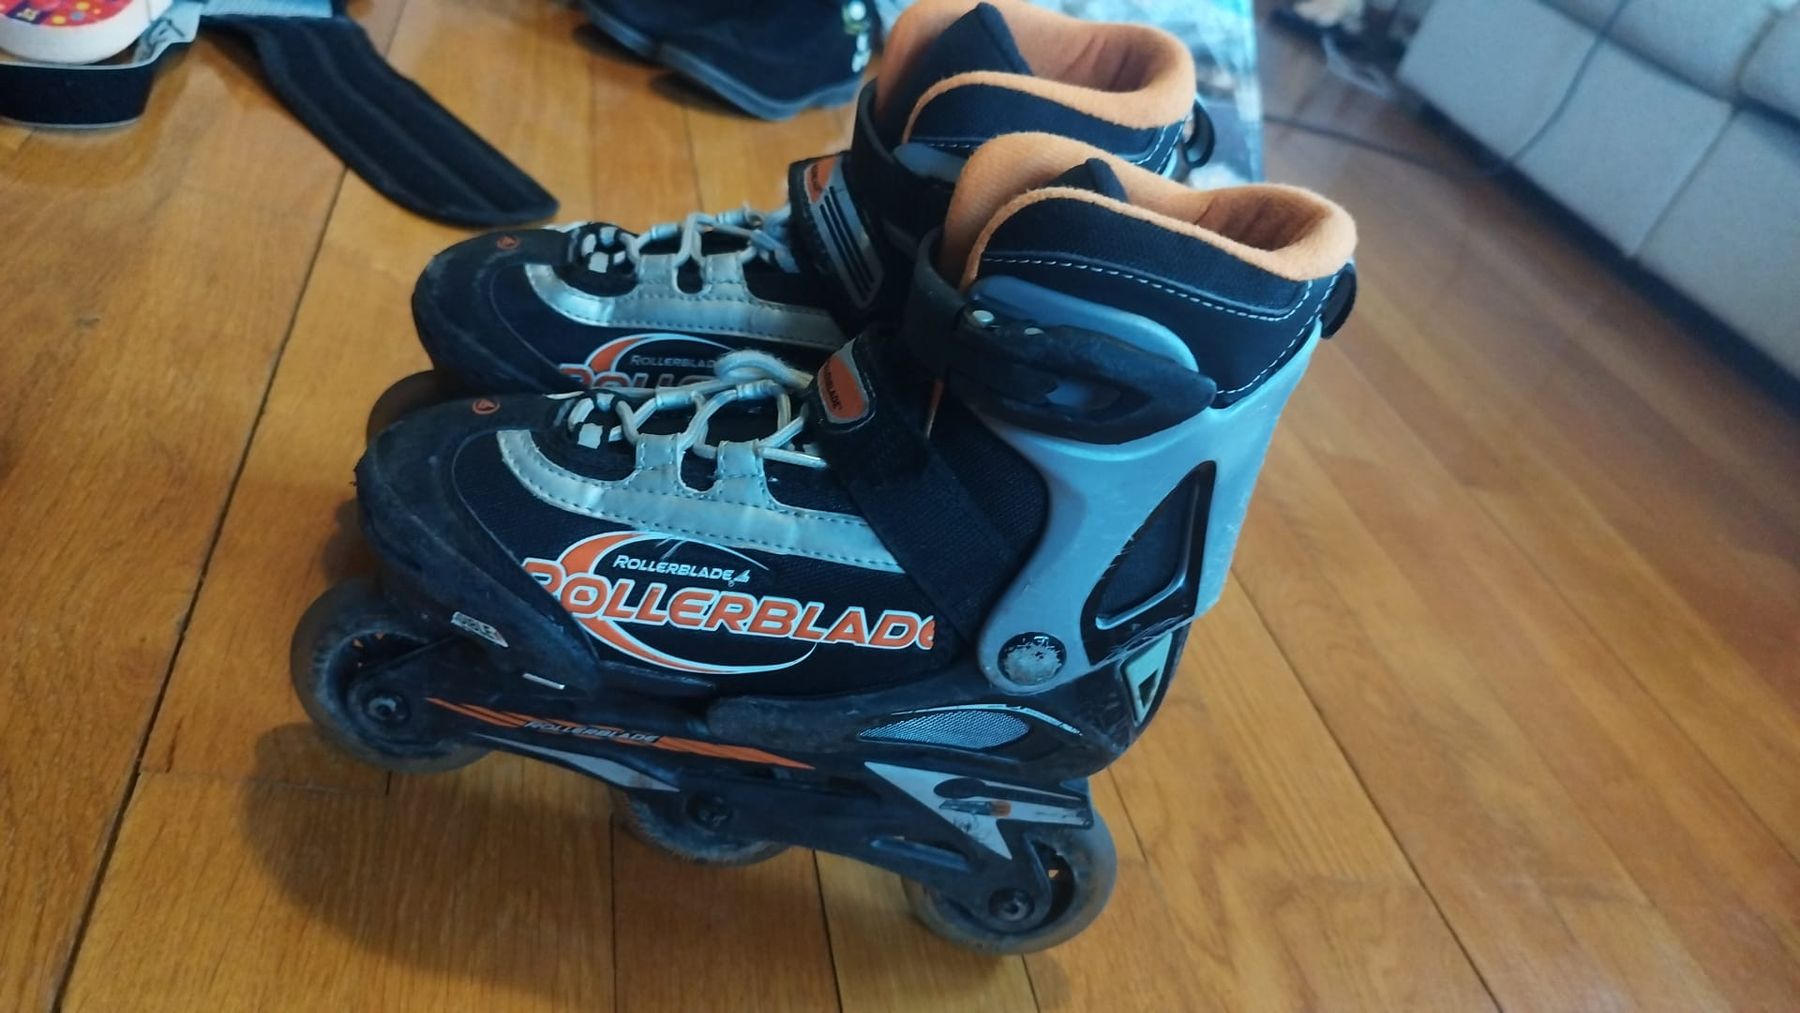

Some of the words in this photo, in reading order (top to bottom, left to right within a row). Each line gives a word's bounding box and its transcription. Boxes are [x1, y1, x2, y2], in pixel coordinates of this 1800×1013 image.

[630, 354, 716, 369] ROLLERBLAD
[612, 554, 735, 581] ROLLERBLADE
[524, 719, 660, 743] ROLLERBLADE
